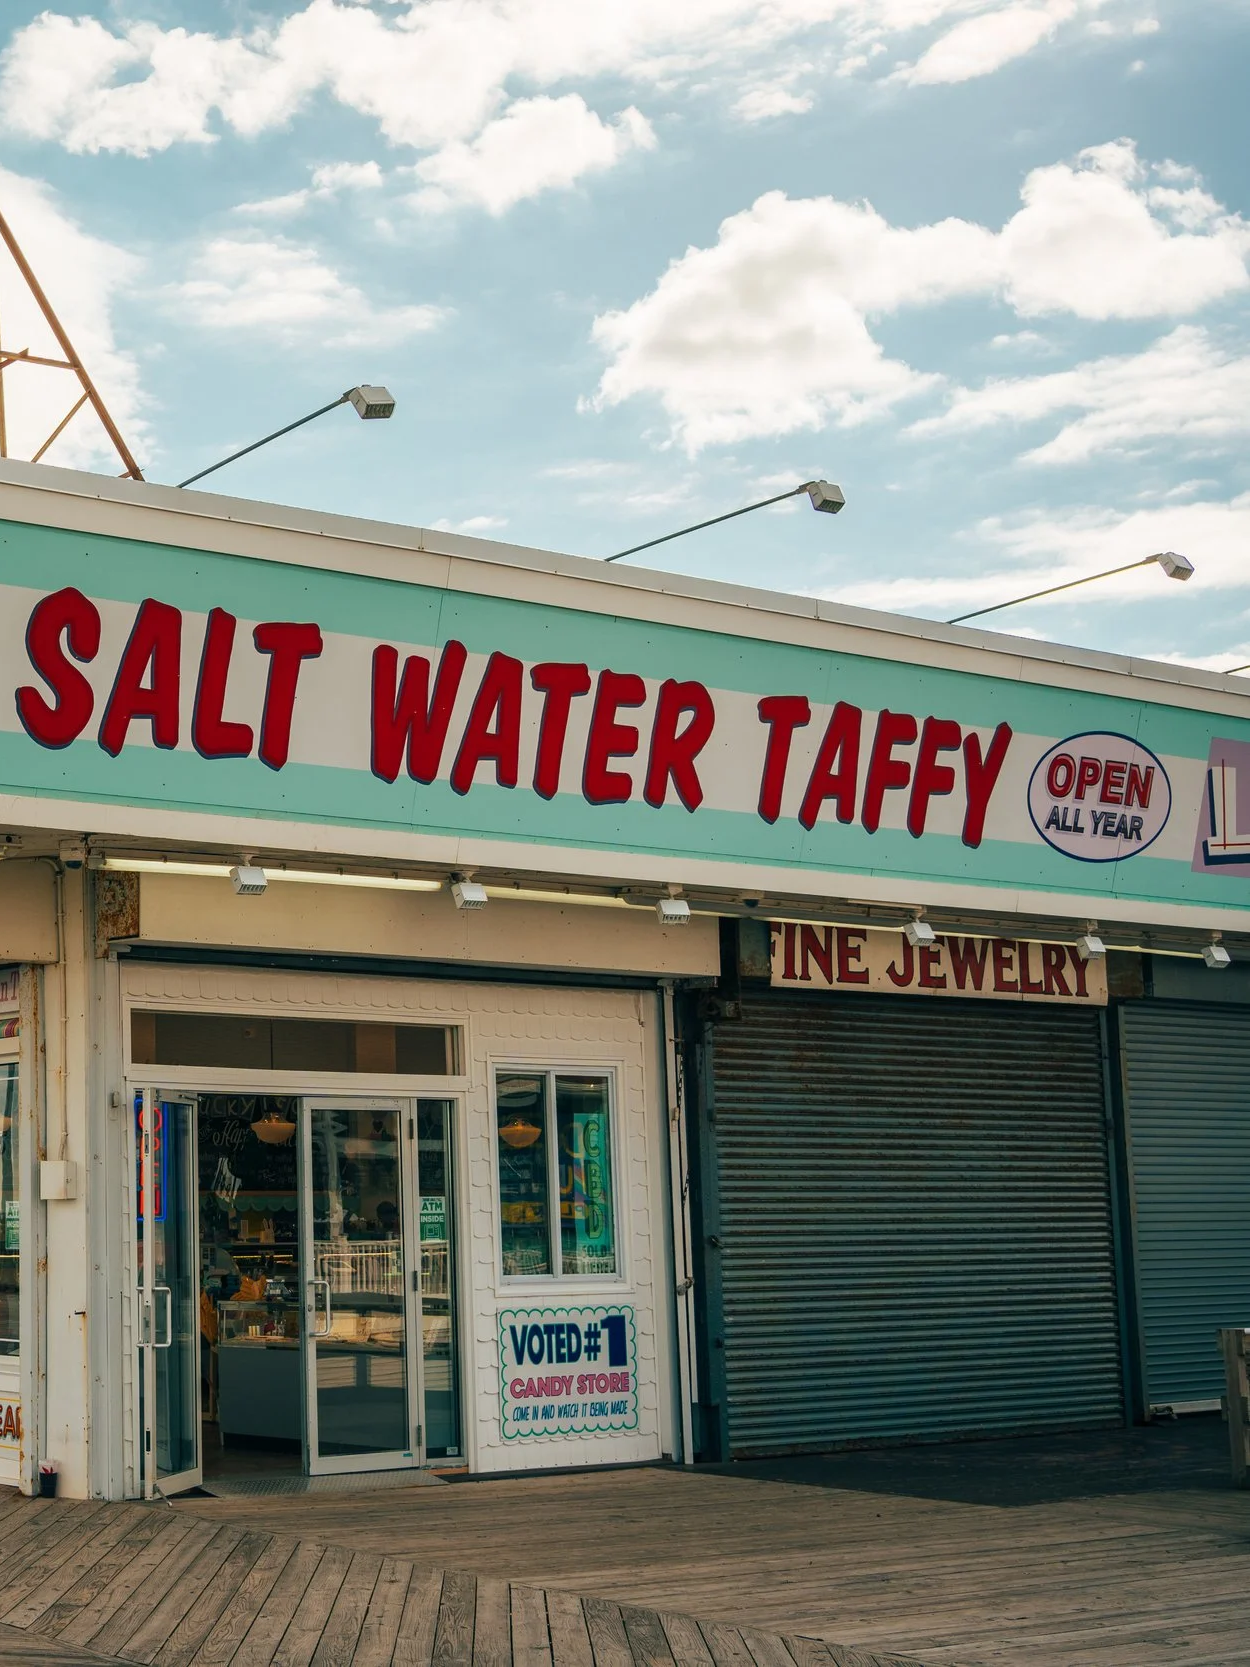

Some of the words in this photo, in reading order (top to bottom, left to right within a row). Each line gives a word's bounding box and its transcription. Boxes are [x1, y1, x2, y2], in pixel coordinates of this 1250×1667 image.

[15, 587, 322, 770] SALT
[370, 640, 715, 813] WATER
[757, 695, 1013, 849] TAFFY
[1047, 753, 1155, 809] OPEN
[1045, 806, 1085, 835] ALL
[1091, 811, 1145, 843] YEAR
[885, 932, 1090, 998] JEWELRY
[420, 1215, 445, 1223] INSIDE
[421, 1202, 443, 1211] ATM
[509, 1323, 582, 1366] VOTED
[584, 1315, 627, 1367] #1
[510, 1375, 574, 1399] CANDY
[576, 1372, 630, 1395] STORE
[512, 1405, 530, 1422] COME
[532, 1405, 539, 1421] IN
[541, 1404, 555, 1420] AND
[558, 1403, 579, 1418] WATCH
[581, 1403, 588, 1418] IT
[589, 1402, 609, 1418] BEING
[610, 1400, 629, 1415] MADE
